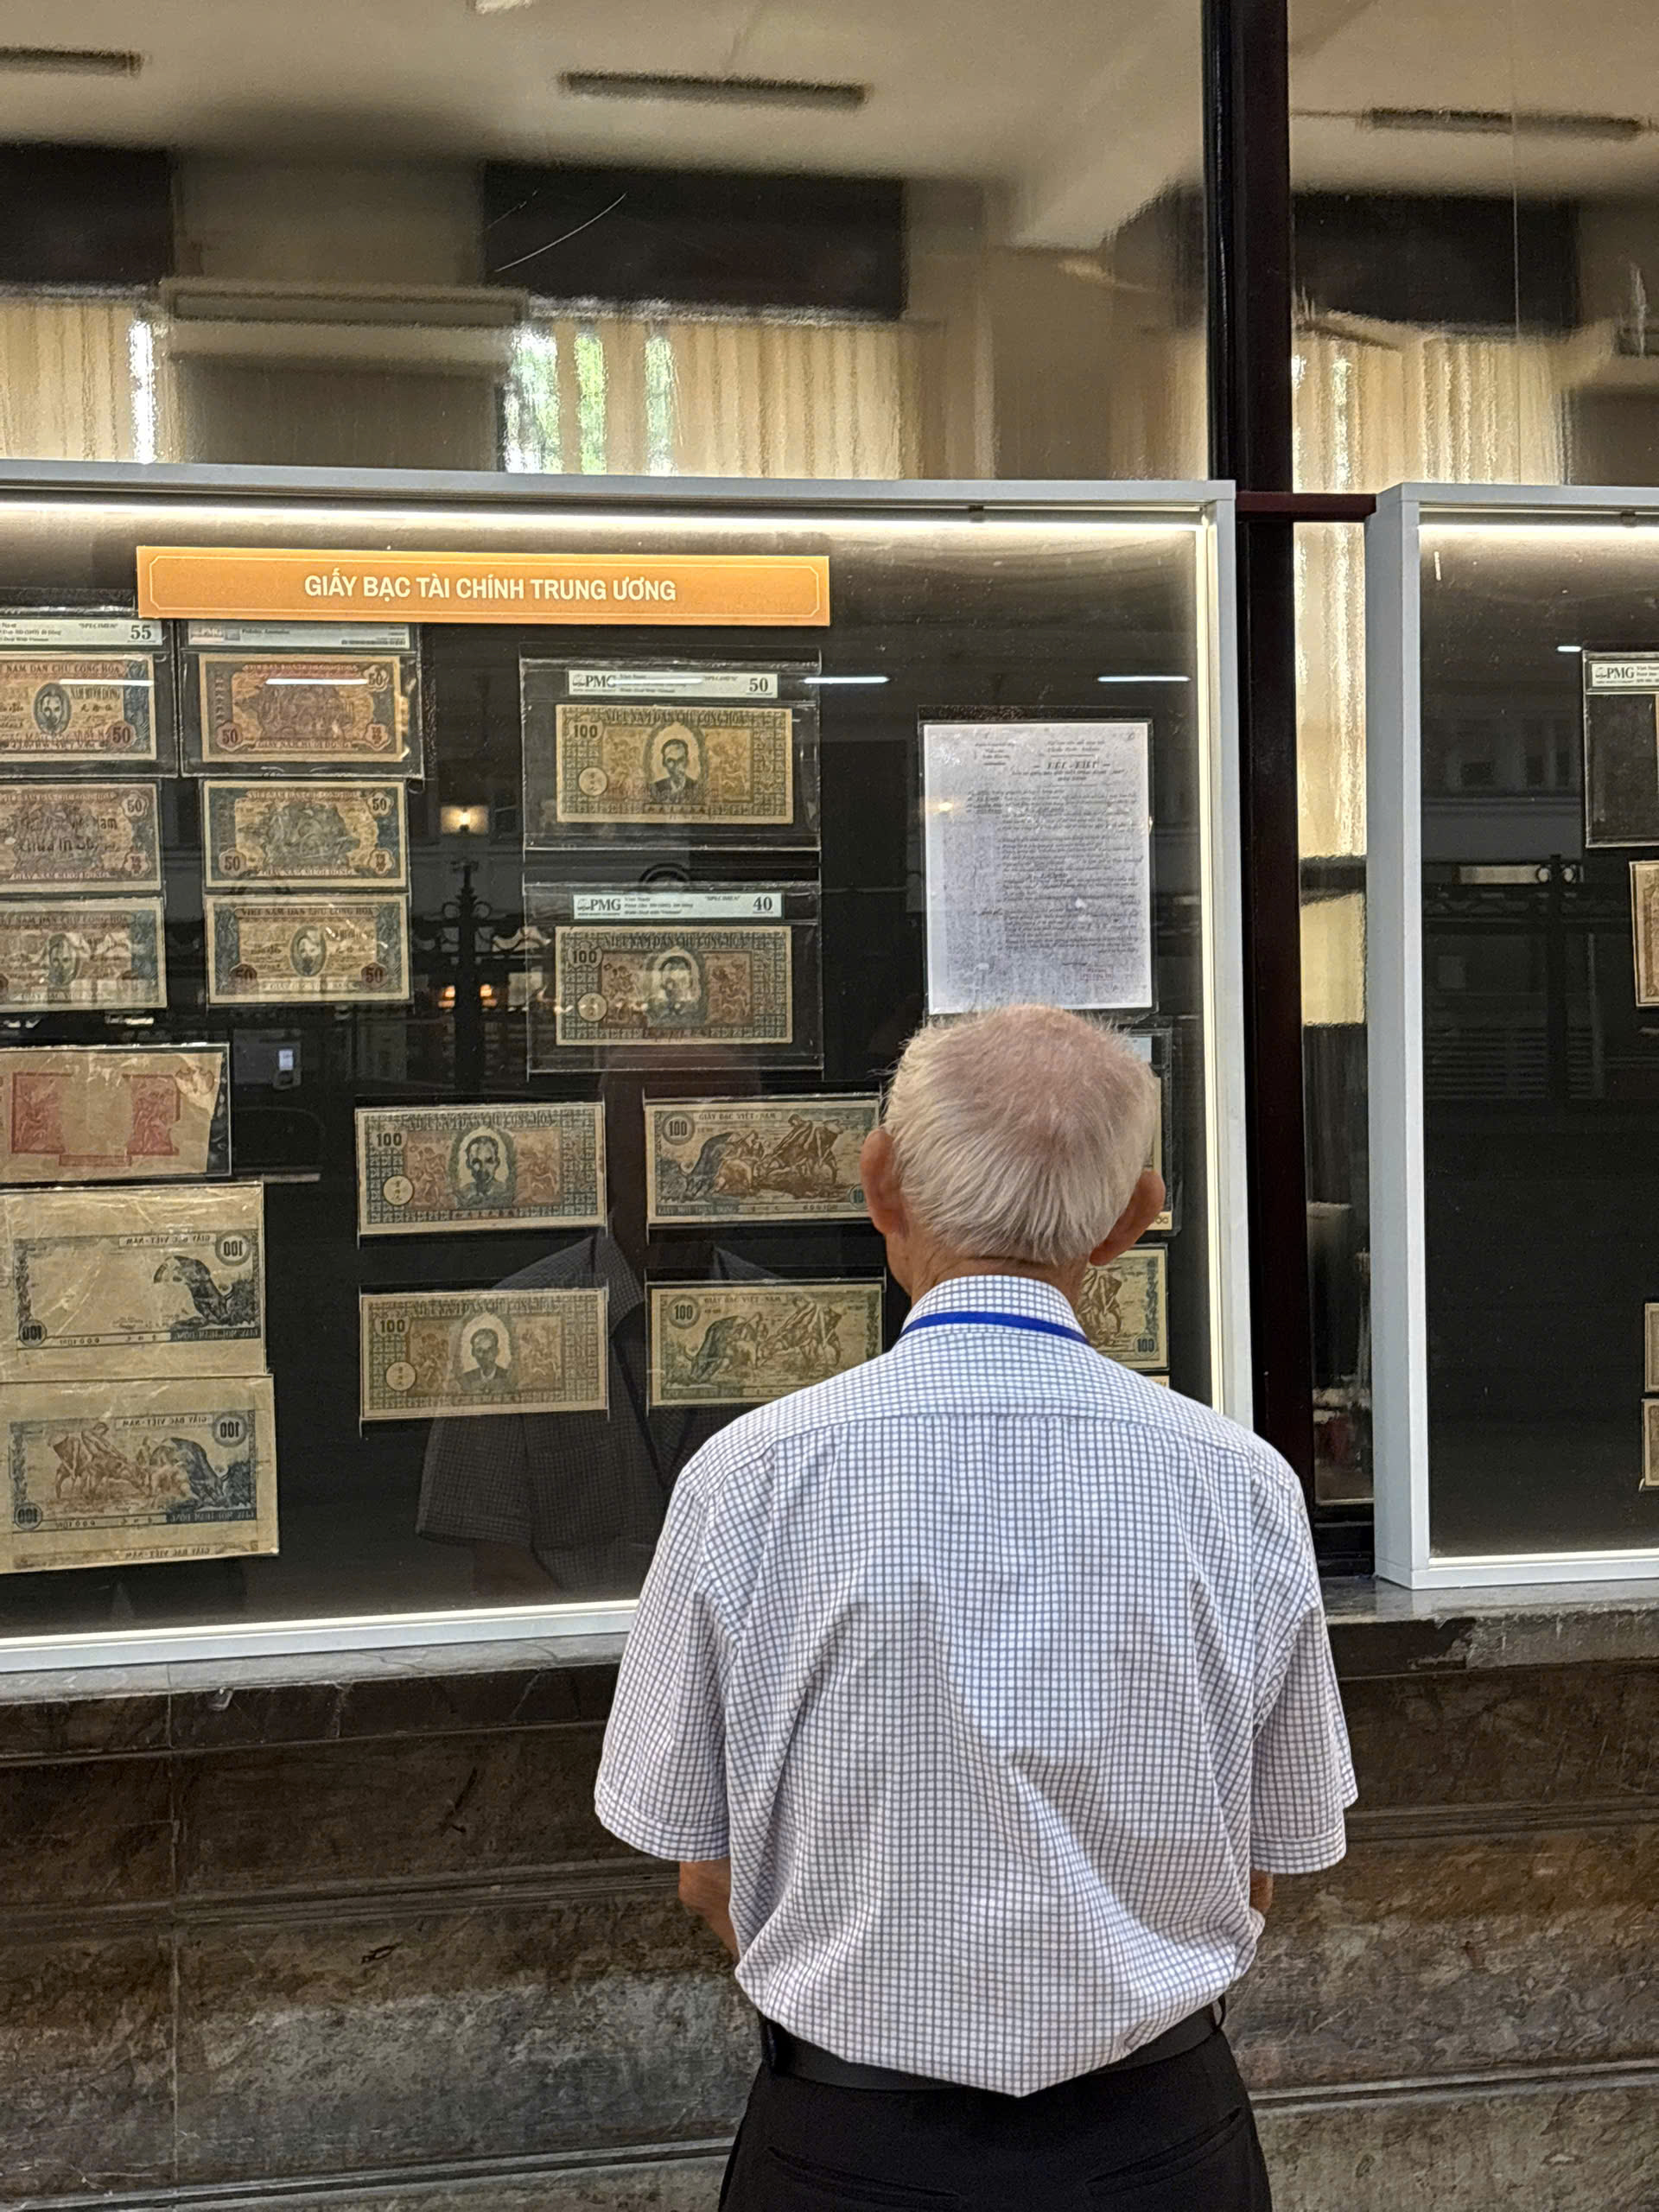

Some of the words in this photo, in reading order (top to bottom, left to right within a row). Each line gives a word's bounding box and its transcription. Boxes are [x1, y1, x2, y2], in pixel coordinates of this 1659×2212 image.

[304, 568, 356, 597] GIẤY
[363, 575, 410, 602] BẠC
[416, 573, 449, 599] TÀI
[455, 575, 524, 599] CHÍNH
[531, 579, 607, 600] TRUNG
[613, 577, 677, 601] ƯƠNG
[130, 624, 151, 639] 55
[1606, 666, 1635, 678] PMG
[749, 677, 769, 692] 50
[112, 727, 130, 744] 50
[222, 729, 238, 743] 50
[573, 724, 598, 738] 100
[127, 800, 143, 812] 50
[372, 798, 387, 810] 50
[224, 856, 240, 870] 50
[590, 899, 621, 911] PMG
[753, 896, 773, 911] 40
[572, 950, 597, 963] 100
[365, 969, 383, 983] 50
[669, 1121, 688, 1136] 100
[376, 1133, 402, 1147] 100
[674, 1305, 694, 1320] 100
[380, 1319, 405, 1333] 100
[1137, 1338, 1155, 1353] 100
